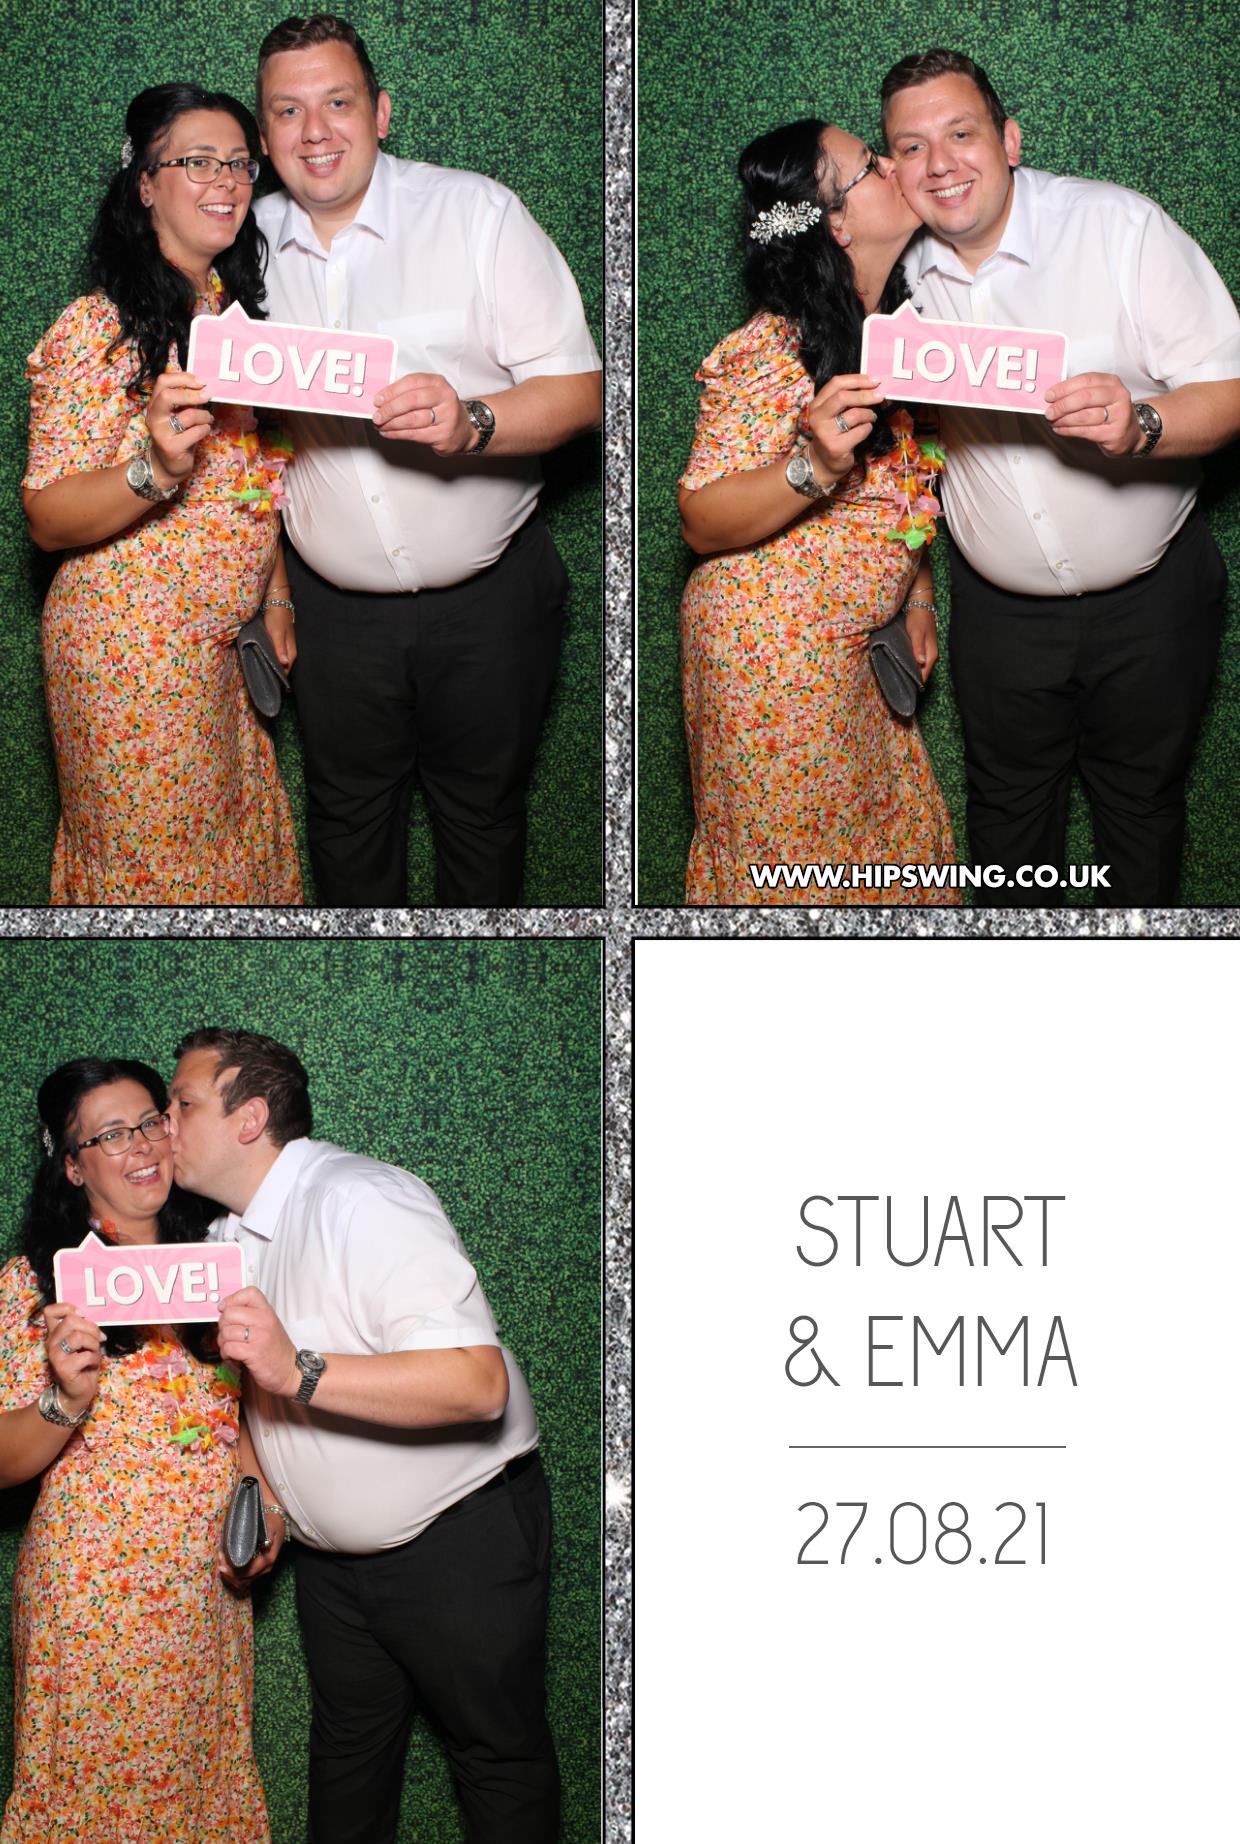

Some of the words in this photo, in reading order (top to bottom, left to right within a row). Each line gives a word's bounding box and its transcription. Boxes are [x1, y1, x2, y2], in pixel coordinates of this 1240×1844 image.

[218, 338, 368, 398] LOVE!
[891, 336, 1039, 394] LOVE!
[84, 1261, 221, 1307] LOVE!
